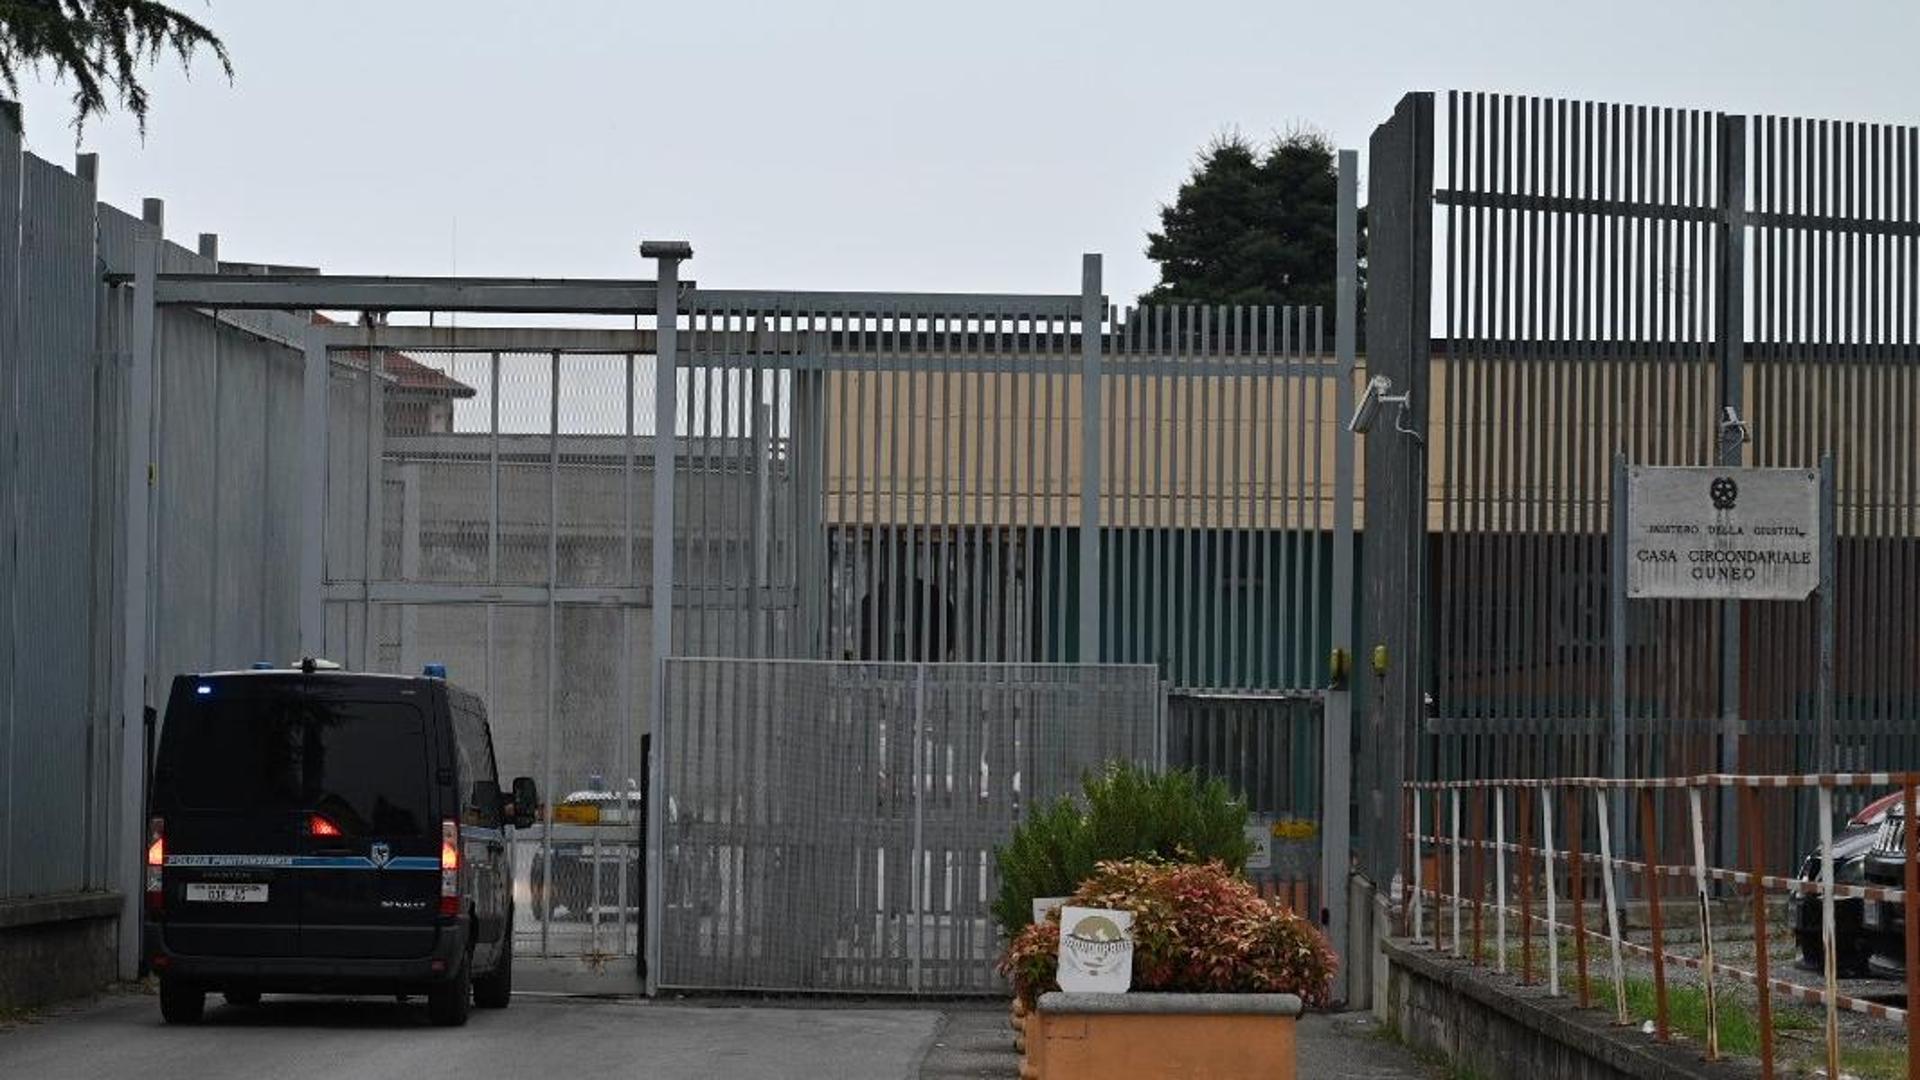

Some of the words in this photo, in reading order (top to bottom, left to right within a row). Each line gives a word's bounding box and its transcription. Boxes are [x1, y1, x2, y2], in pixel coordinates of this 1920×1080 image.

[1708, 526, 1744, 536] DELLA
[1636, 551, 1678, 563] CASA
[1689, 551, 1811, 564] CIRCONDARIALE
[1693, 568, 1755, 580] CUNEO
